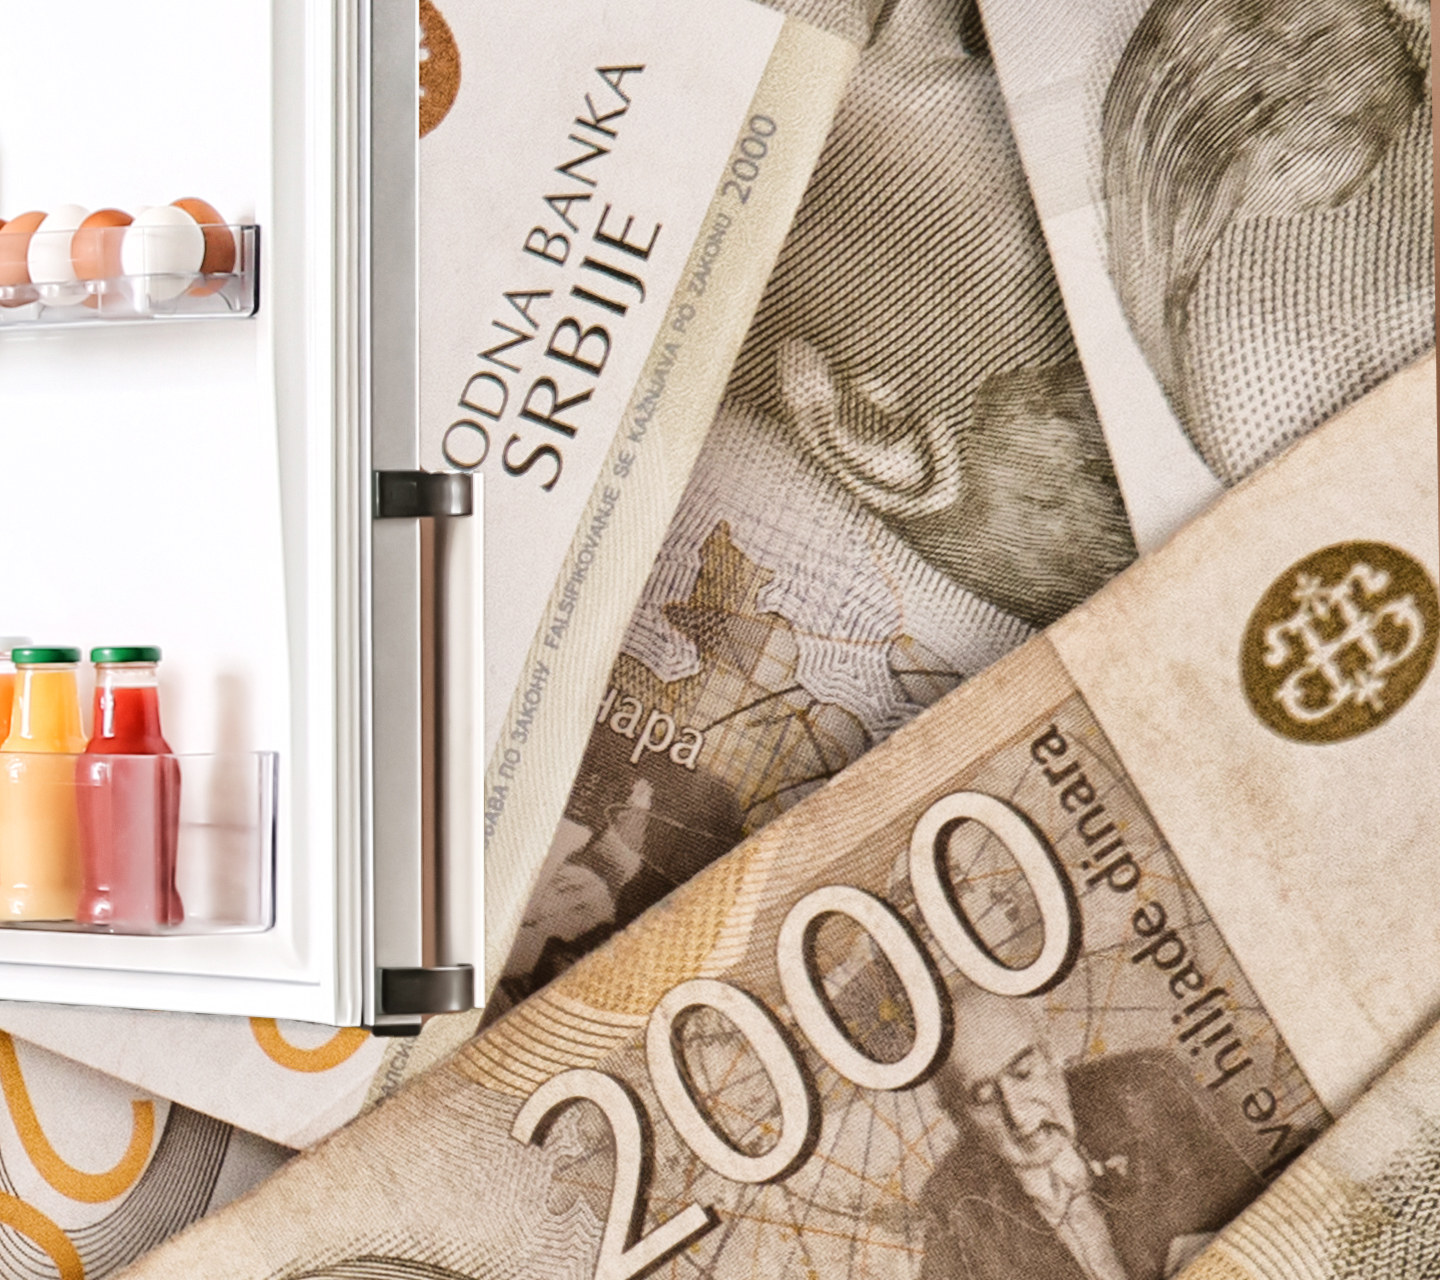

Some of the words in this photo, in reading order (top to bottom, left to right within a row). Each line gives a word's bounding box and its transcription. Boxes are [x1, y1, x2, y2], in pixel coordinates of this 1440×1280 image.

[521, 62, 647, 269] BANKA
[688, 211, 732, 298] ZAKONU
[720, 113, 779, 206] 2000
[500, 202, 664, 494] SRBIJE
[1028, 722, 1143, 895] dinara
[1130, 899, 1255, 1091] hiljade
